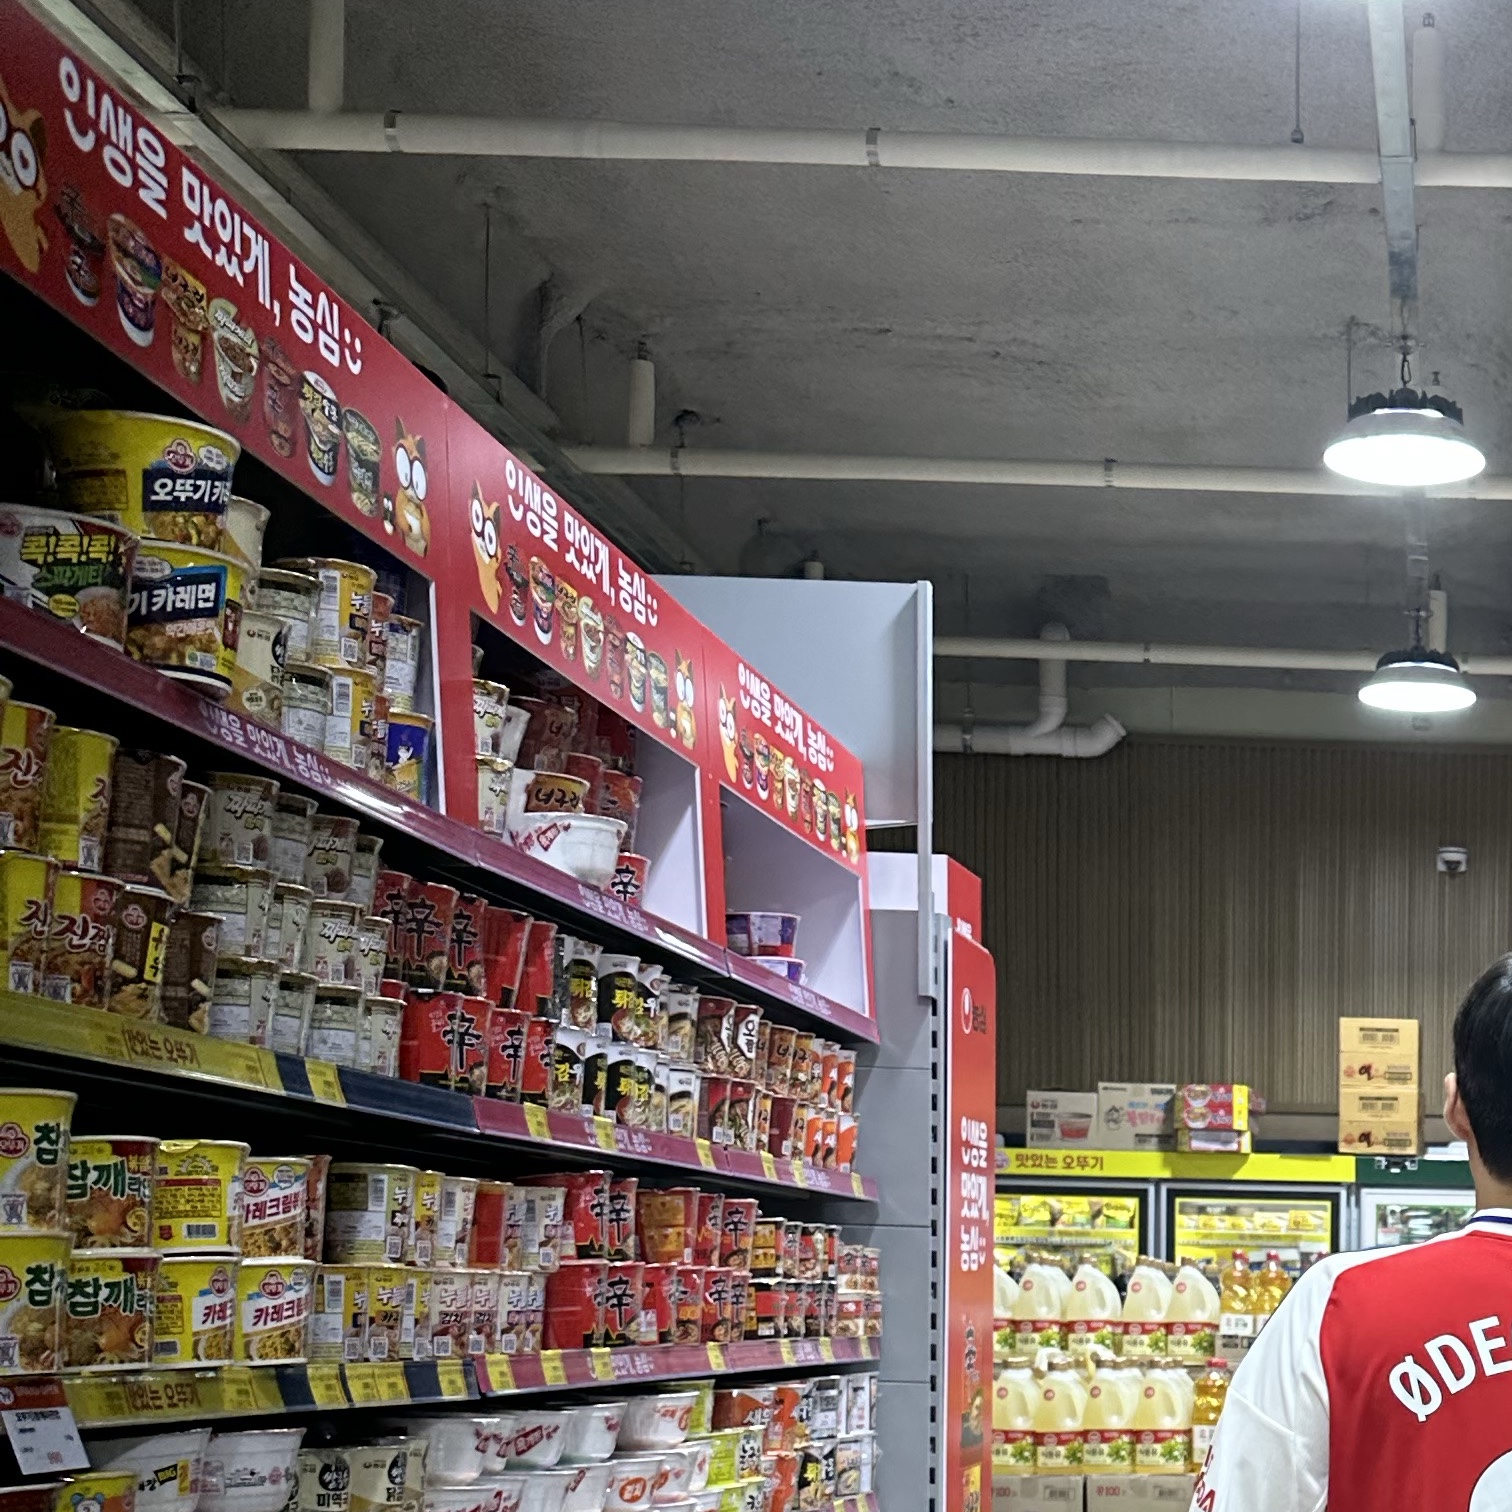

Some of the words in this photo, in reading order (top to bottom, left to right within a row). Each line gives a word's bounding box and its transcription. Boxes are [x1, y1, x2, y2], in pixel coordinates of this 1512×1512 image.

[59, 57, 166, 219] 인생을
[182, 165, 282, 327] 맛있게,
[288, 262, 341, 375] 농심
[151, 477, 208, 502] 오뚜기
[21, 534, 116, 564] 콕!콕!콕!
[505, 459, 558, 552] 인생을
[565, 517, 615, 606] 맛있게,
[618, 558, 648, 626] 농심
[152, 582, 216, 612] 카레면
[739, 663, 772, 728] 인생을
[807, 729, 828, 773] 농심
[611, 864, 641, 901] 辛
[405, 896, 443, 960] 辛
[449, 909, 478, 969] 辛
[164, 1039, 198, 1068] 오뚜기
[34, 1121, 60, 1166] 참
[961, 1116, 988, 1168] 인생을
[1015, 1153, 1058, 1169] 맛있는
[1061, 1155, 1104, 1171] 오뚜기
[67, 1160, 127, 1201] 참깨
[608, 1190, 631, 1245] 辛
[724, 1207, 749, 1249] 辛
[25, 1264, 58, 1306] 참
[68, 1276, 136, 1318] 참깨
[605, 1275, 635, 1330] 辛
[165, 1382, 197, 1410] 오뚜기
